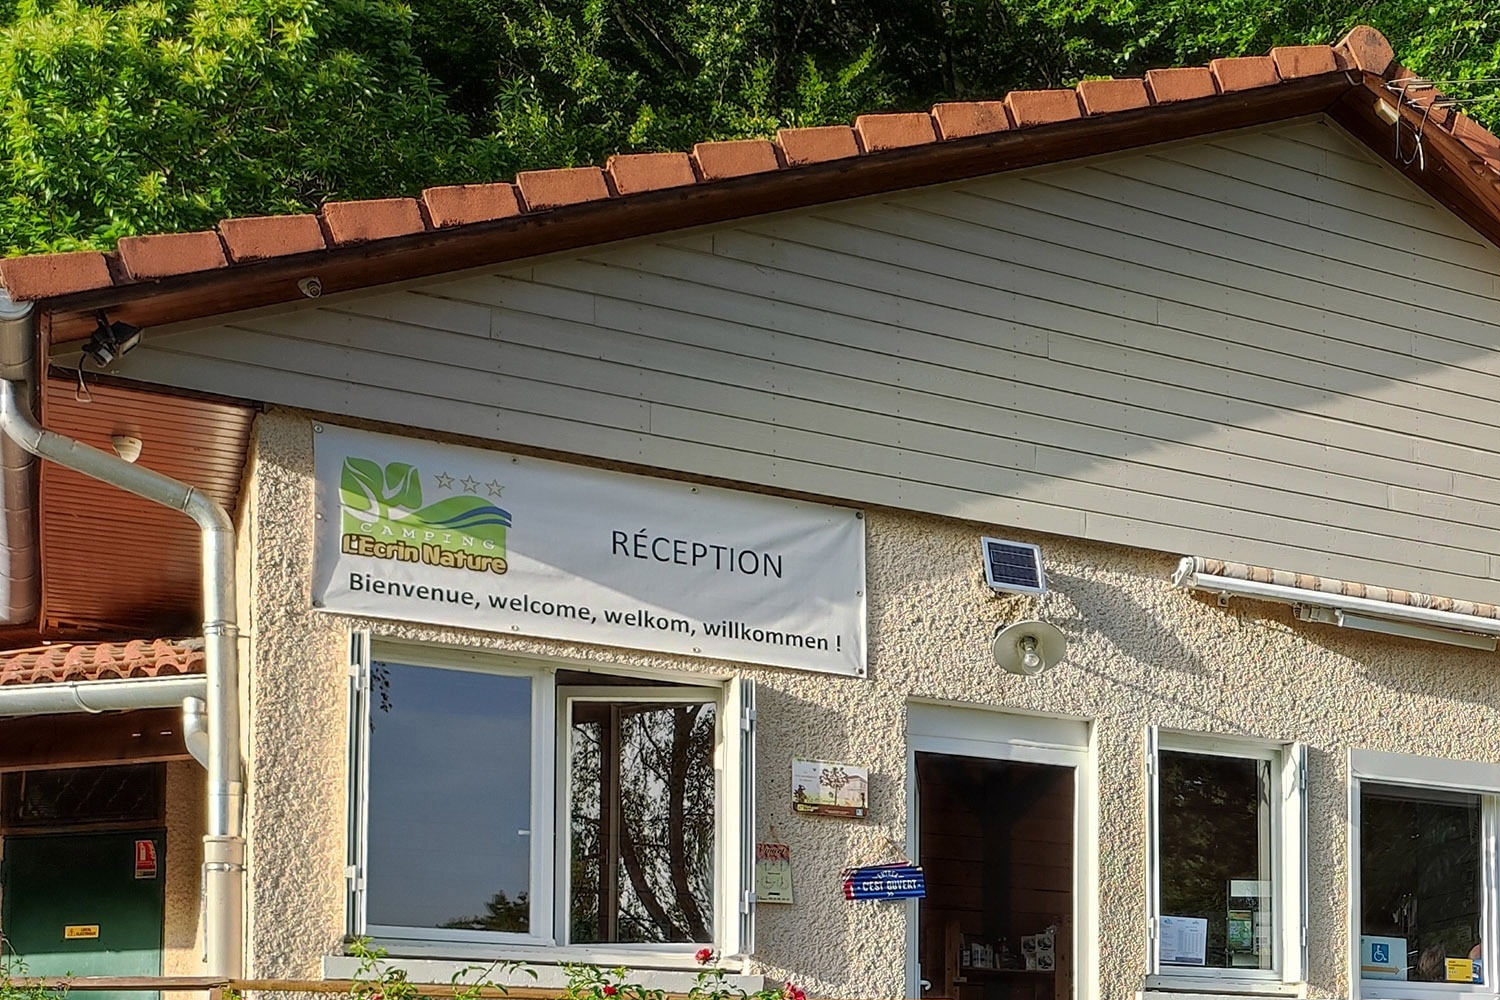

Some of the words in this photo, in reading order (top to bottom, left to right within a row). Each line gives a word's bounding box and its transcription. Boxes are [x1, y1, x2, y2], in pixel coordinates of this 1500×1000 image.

[341, 533, 420, 563] L'Ecrin
[421, 543, 508, 575] Nature
[360, 522, 496, 550] CAMPING
[611, 528, 783, 579] RÉCEPTION
[349, 572, 481, 610] Bienvenue,
[488, 594, 598, 625] welcome,
[603, 609, 697, 638] welkom,
[702, 620, 829, 651] willkommen
[886, 879, 917, 890] OUVERT
